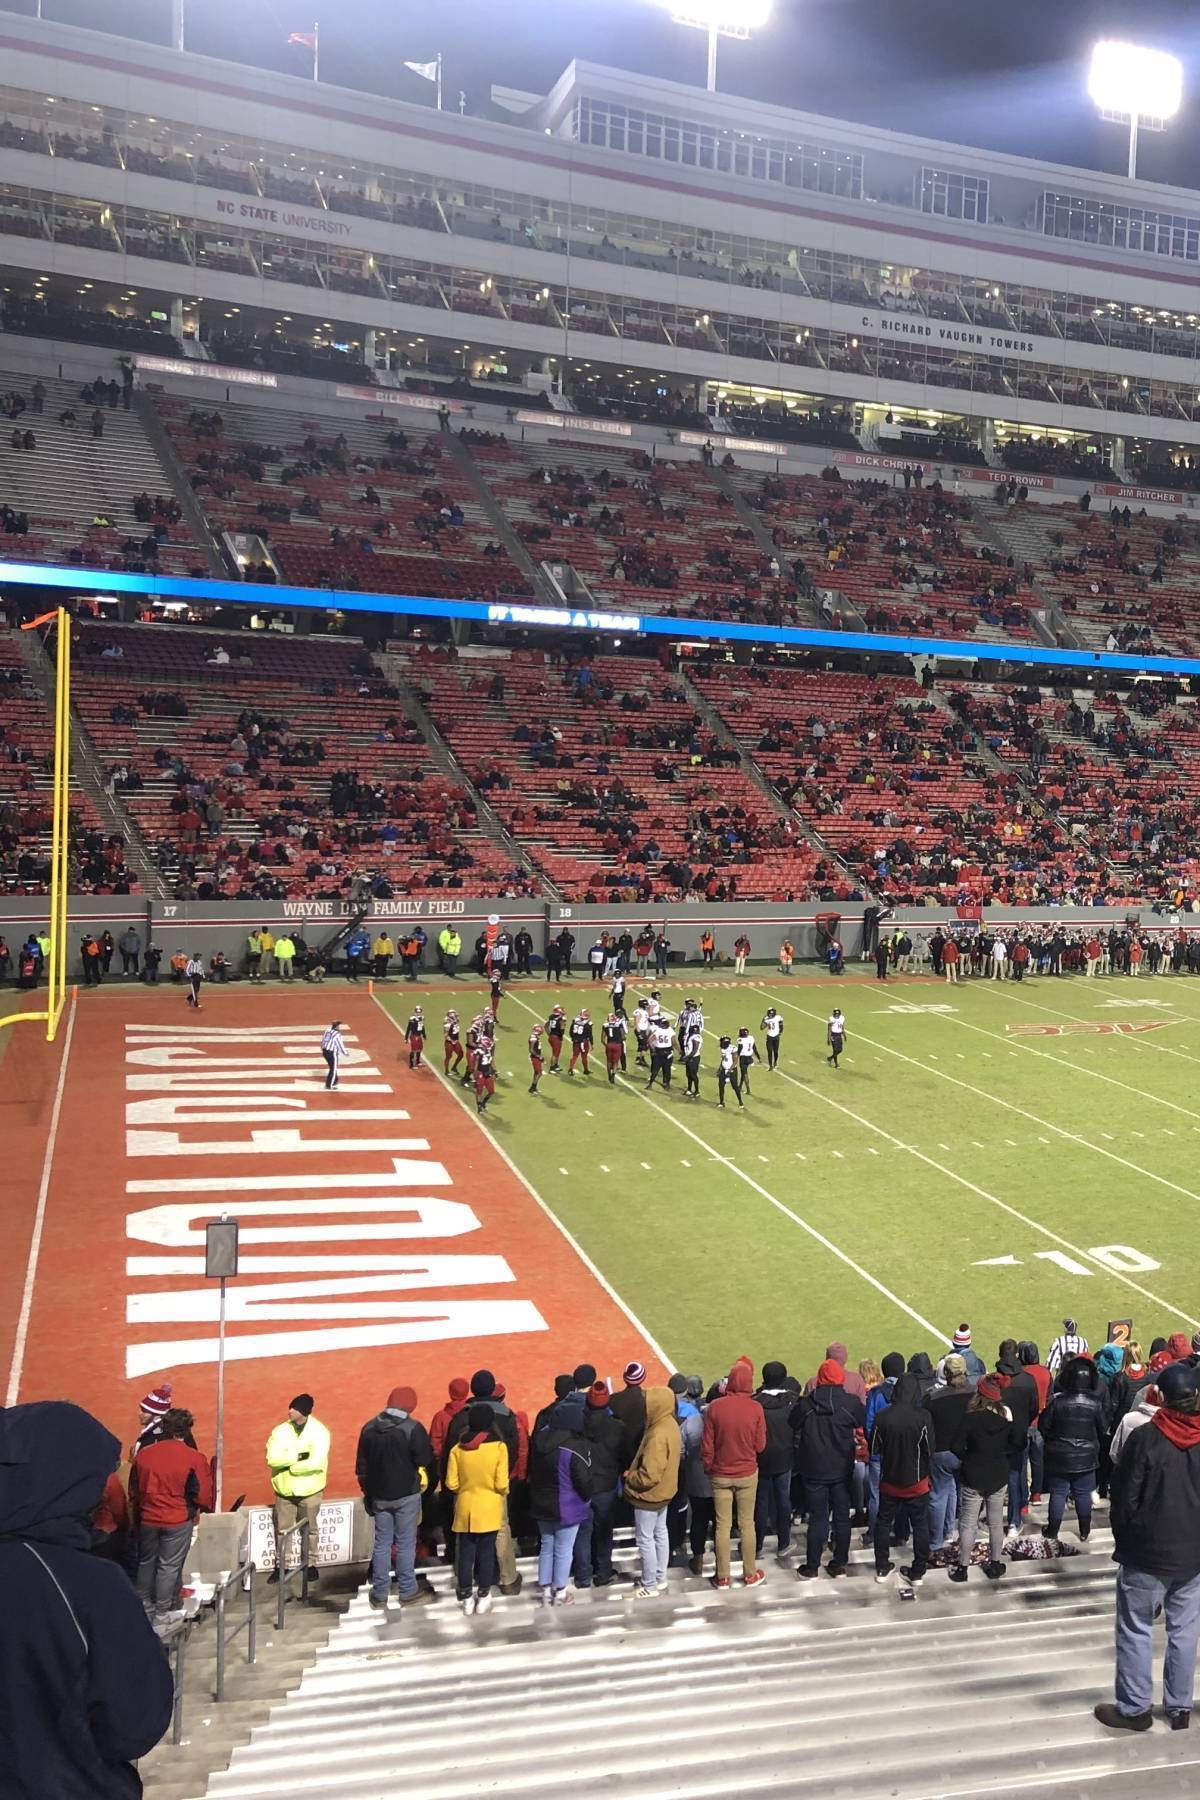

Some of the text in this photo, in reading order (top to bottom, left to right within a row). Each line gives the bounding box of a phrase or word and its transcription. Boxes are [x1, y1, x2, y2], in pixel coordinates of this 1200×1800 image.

[217, 200, 352, 236] NC STATE UNIVERSITY
[862, 317, 1034, 352] C. RICHARD VAUGHN TOWERS
[376, 391, 403, 404] BILL
[856, 455, 926, 472] DICK CHRISTY
[989, 472, 1007, 483] TED
[1118, 488, 1177, 502] JIM RITCHER
[572, 612, 588, 627] A
[163, 906, 177, 917] 17
[283, 902, 333, 916] WAYNE
[374, 900, 423, 915] FAMILY
[428, 900, 465, 915] FIELD
[559, 908, 572, 918] 18
[1170, 915, 1180, 924] 20
[125, 1023, 550, 1379] WOLFPACK
[1034, 1245, 1162, 1276] 10
[1112, 1324, 1130, 1347] 2
[322, 1517, 344, 1525] AND
